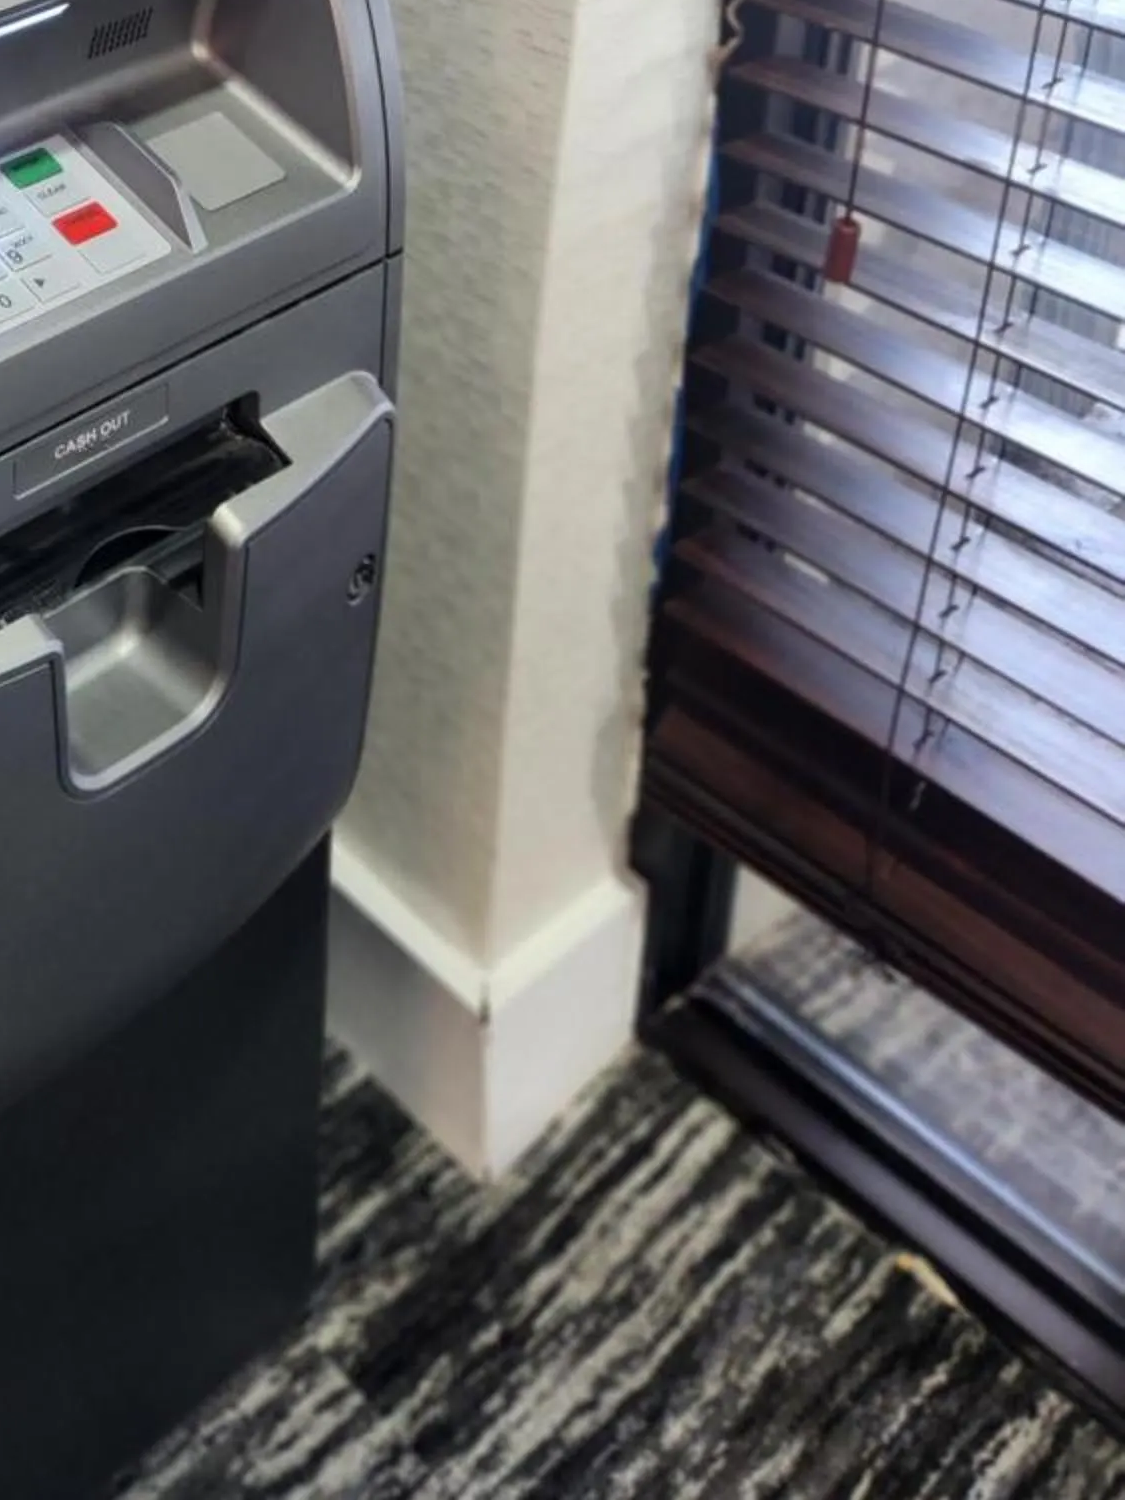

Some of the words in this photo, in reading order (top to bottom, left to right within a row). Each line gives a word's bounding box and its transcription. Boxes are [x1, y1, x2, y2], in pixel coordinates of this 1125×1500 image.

[5, 248, 25, 265] 9
[53, 427, 98, 461] CASH
[99, 410, 131, 437] OUT
